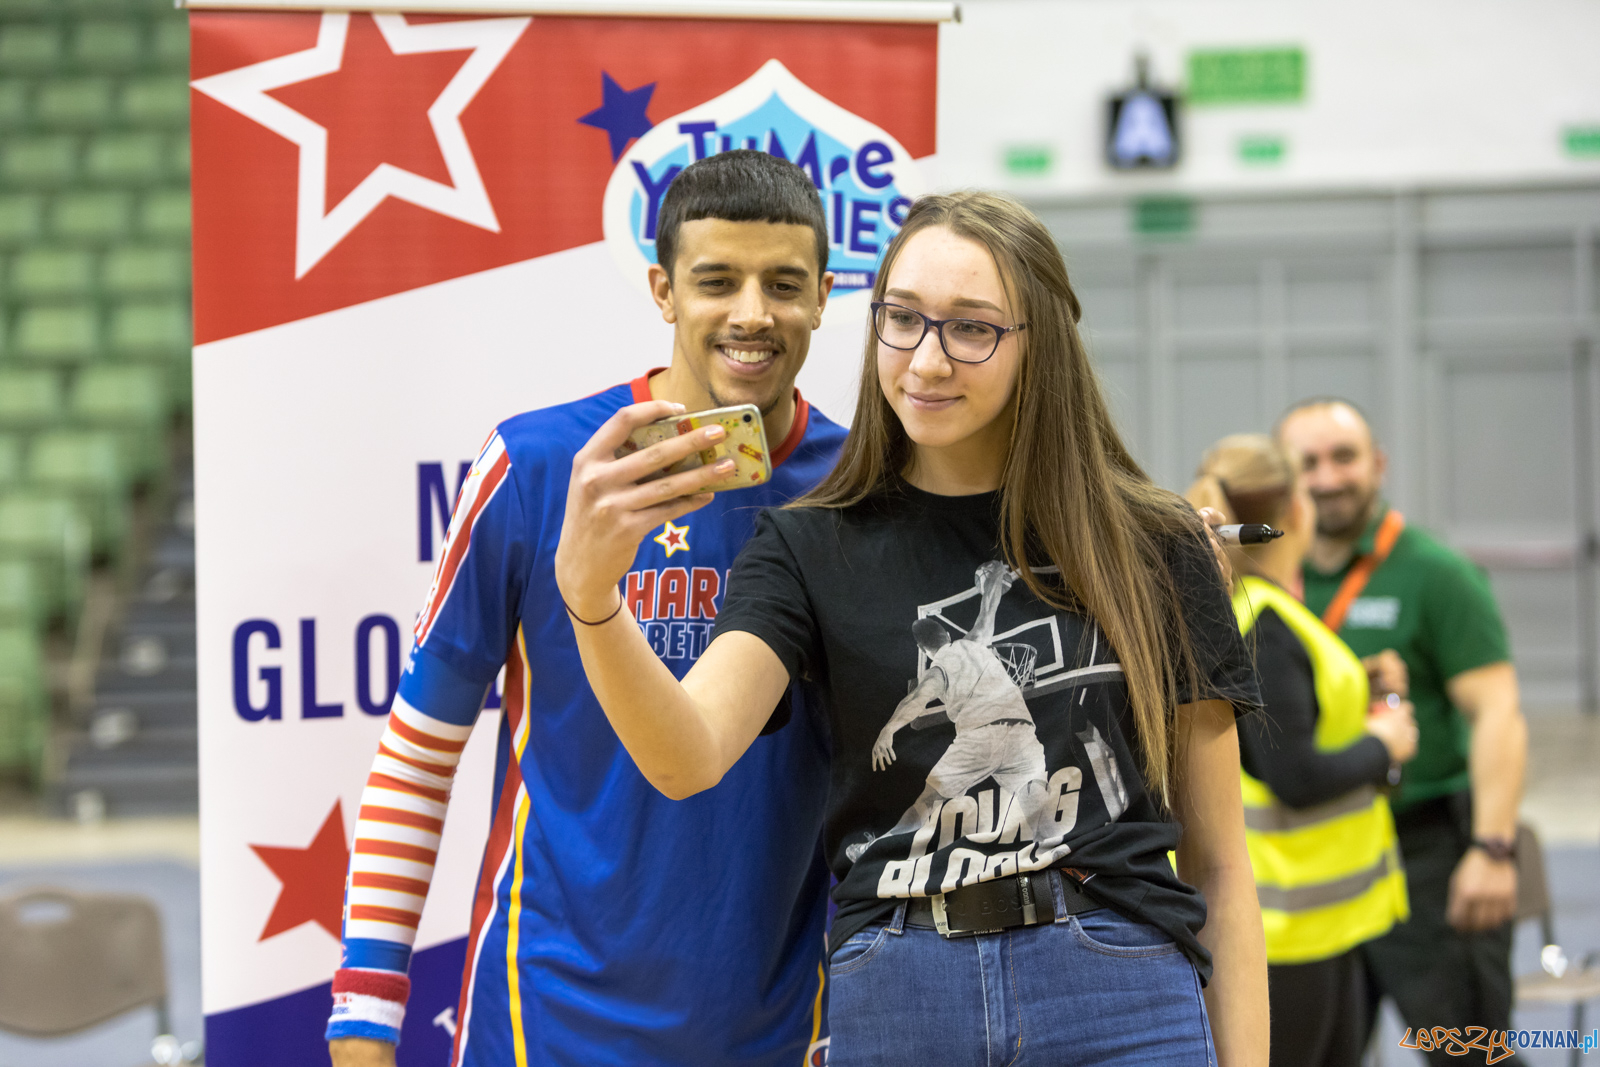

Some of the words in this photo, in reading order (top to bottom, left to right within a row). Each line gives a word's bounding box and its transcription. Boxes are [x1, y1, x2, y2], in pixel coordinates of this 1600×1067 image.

[625, 567, 731, 622] HAR
[232, 613, 402, 722] GLO
[637, 621, 716, 660] BET
